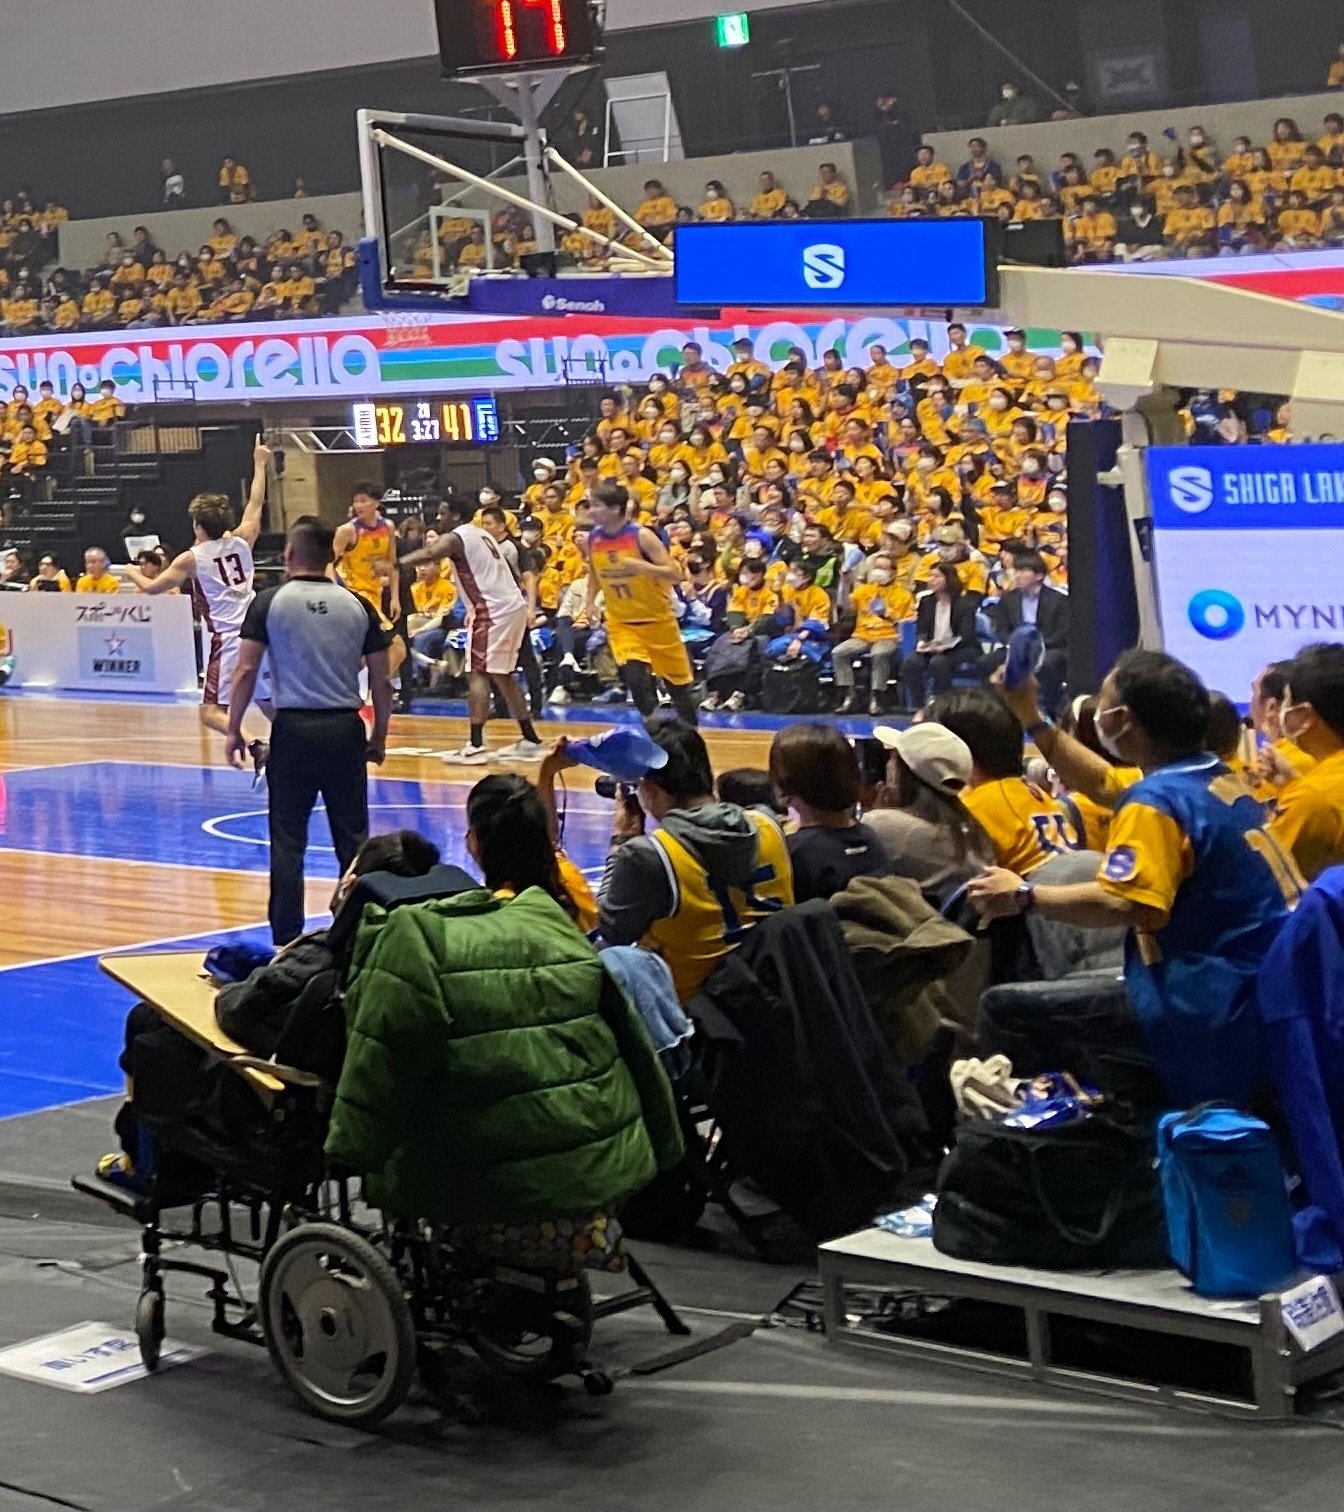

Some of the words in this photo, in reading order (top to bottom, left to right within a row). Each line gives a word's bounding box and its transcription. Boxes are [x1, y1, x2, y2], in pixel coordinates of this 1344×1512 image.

[376, 407, 406, 443] 32
[411, 419, 439, 440] 3:27
[442, 403, 473, 441] 41
[1224, 472, 1296, 505] SHIGA
[213, 553, 246, 586] 13
[93, 659, 141, 674] WINNER
